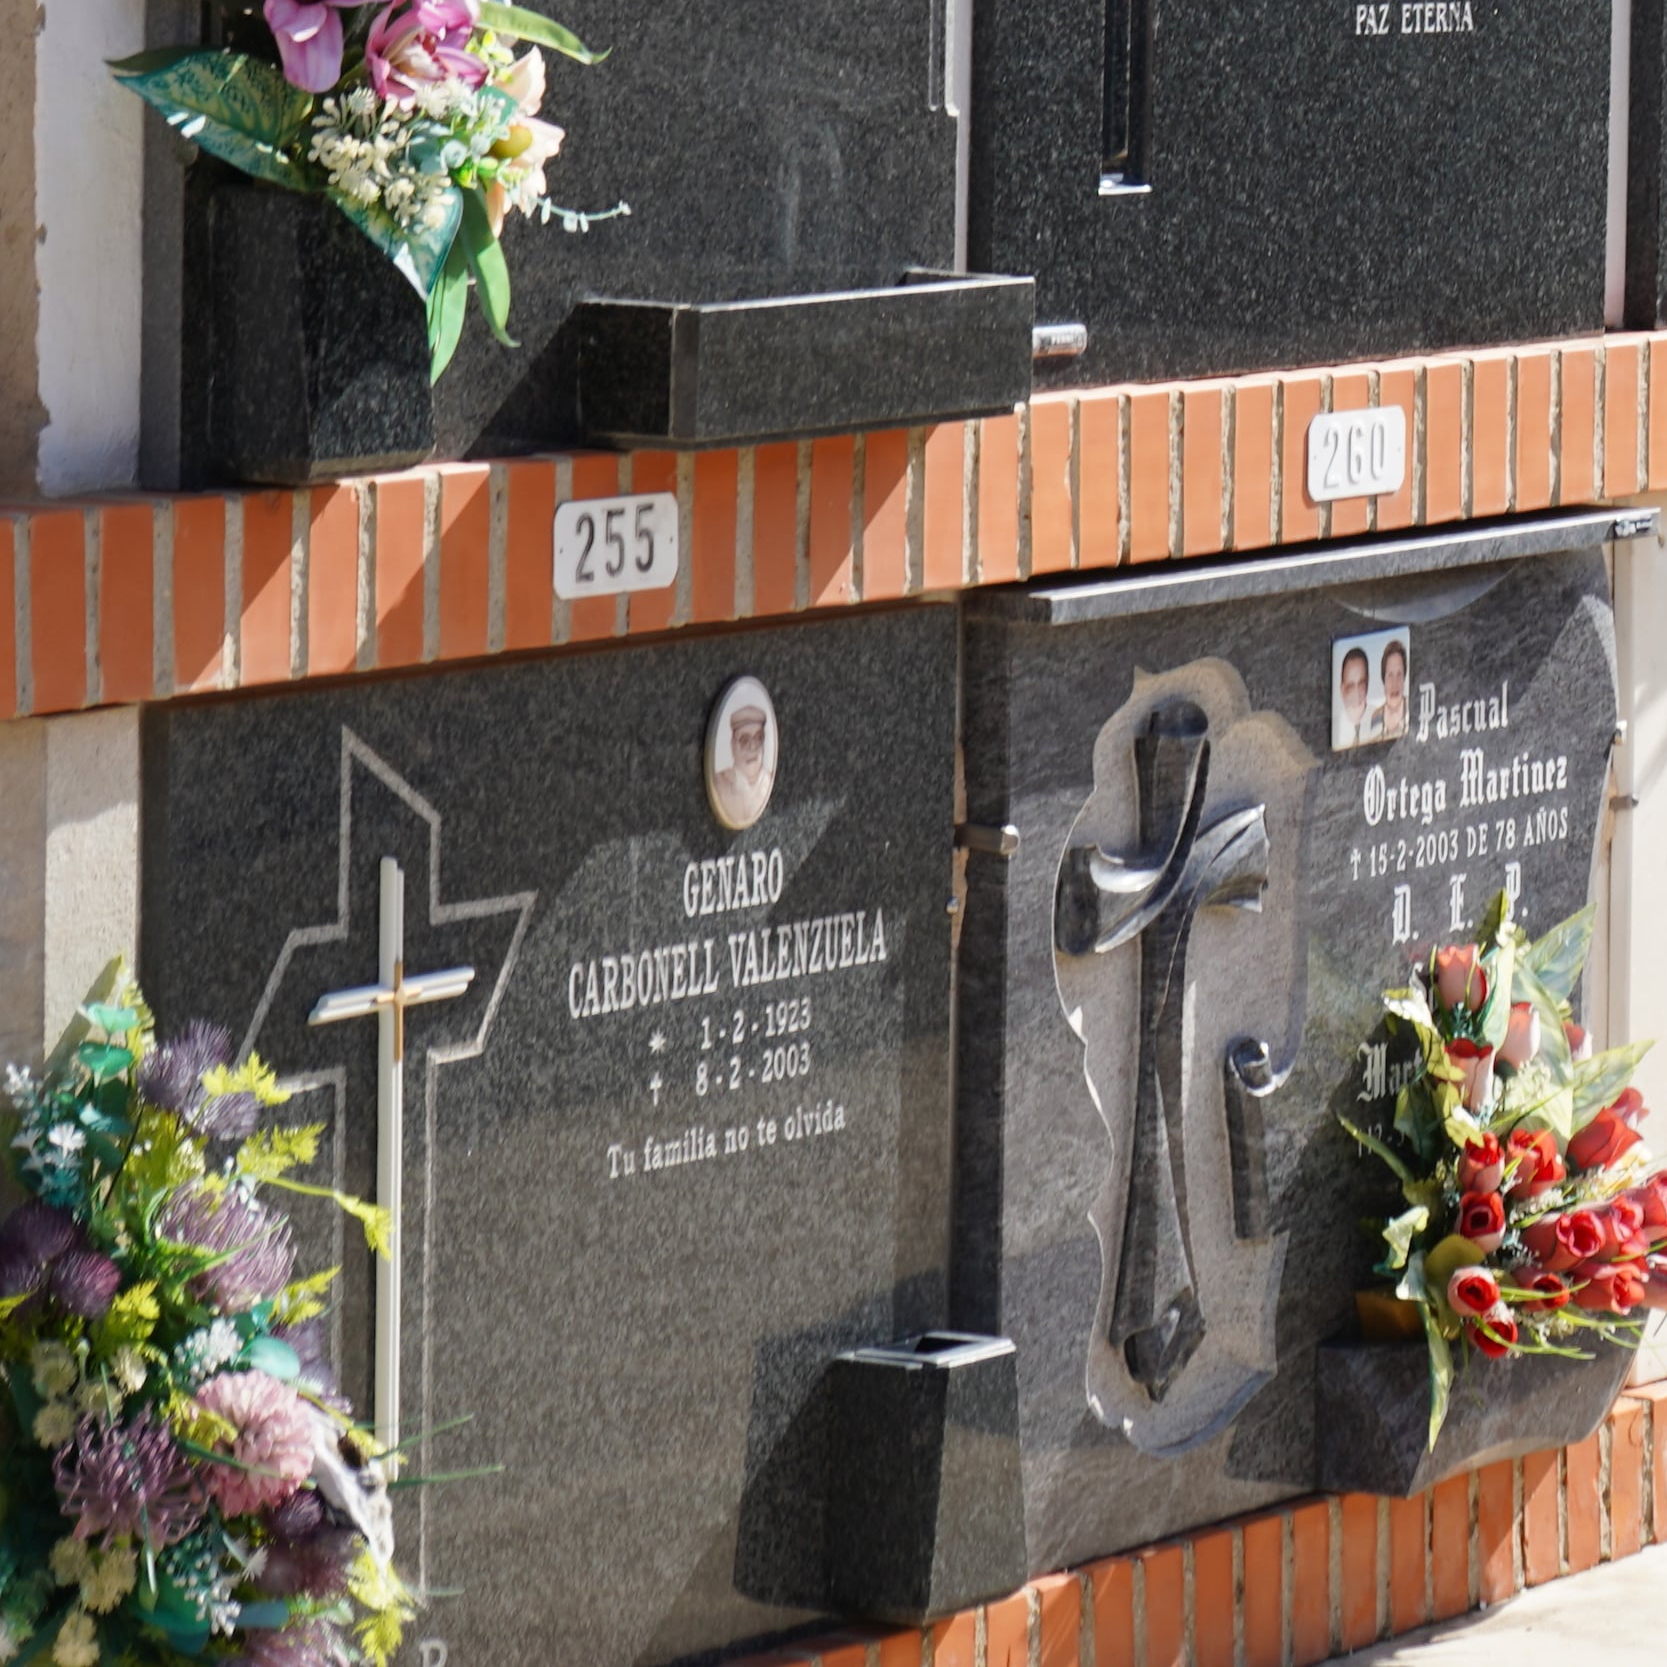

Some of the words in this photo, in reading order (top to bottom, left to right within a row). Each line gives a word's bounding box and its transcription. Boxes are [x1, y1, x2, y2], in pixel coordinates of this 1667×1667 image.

[1356, 4, 1389, 36] PAZ
[1401, 1, 1474, 33] ETERNA
[1322, 422, 1384, 488] 260
[576, 503, 655, 583] 255
[1416, 680, 1508, 744] Pascual
[1363, 765, 1447, 826] Ortega
[1460, 747, 1568, 808] Martinez
[1467, 823, 1489, 858] DE
[1496, 817, 1515, 852] 78
[1524, 806, 1568, 846] AÑOS
[683, 848, 784, 918] GENARO
[569, 938, 720, 1019] CARBONELL
[728, 908, 887, 987] VALENZUELA
[607, 1144, 636, 1179] Tu
[643, 1126, 717, 1172] familia
[724, 1123, 749, 1155] no
[757, 1116, 777, 1146] te
[784, 1099, 845, 1141] olvida
